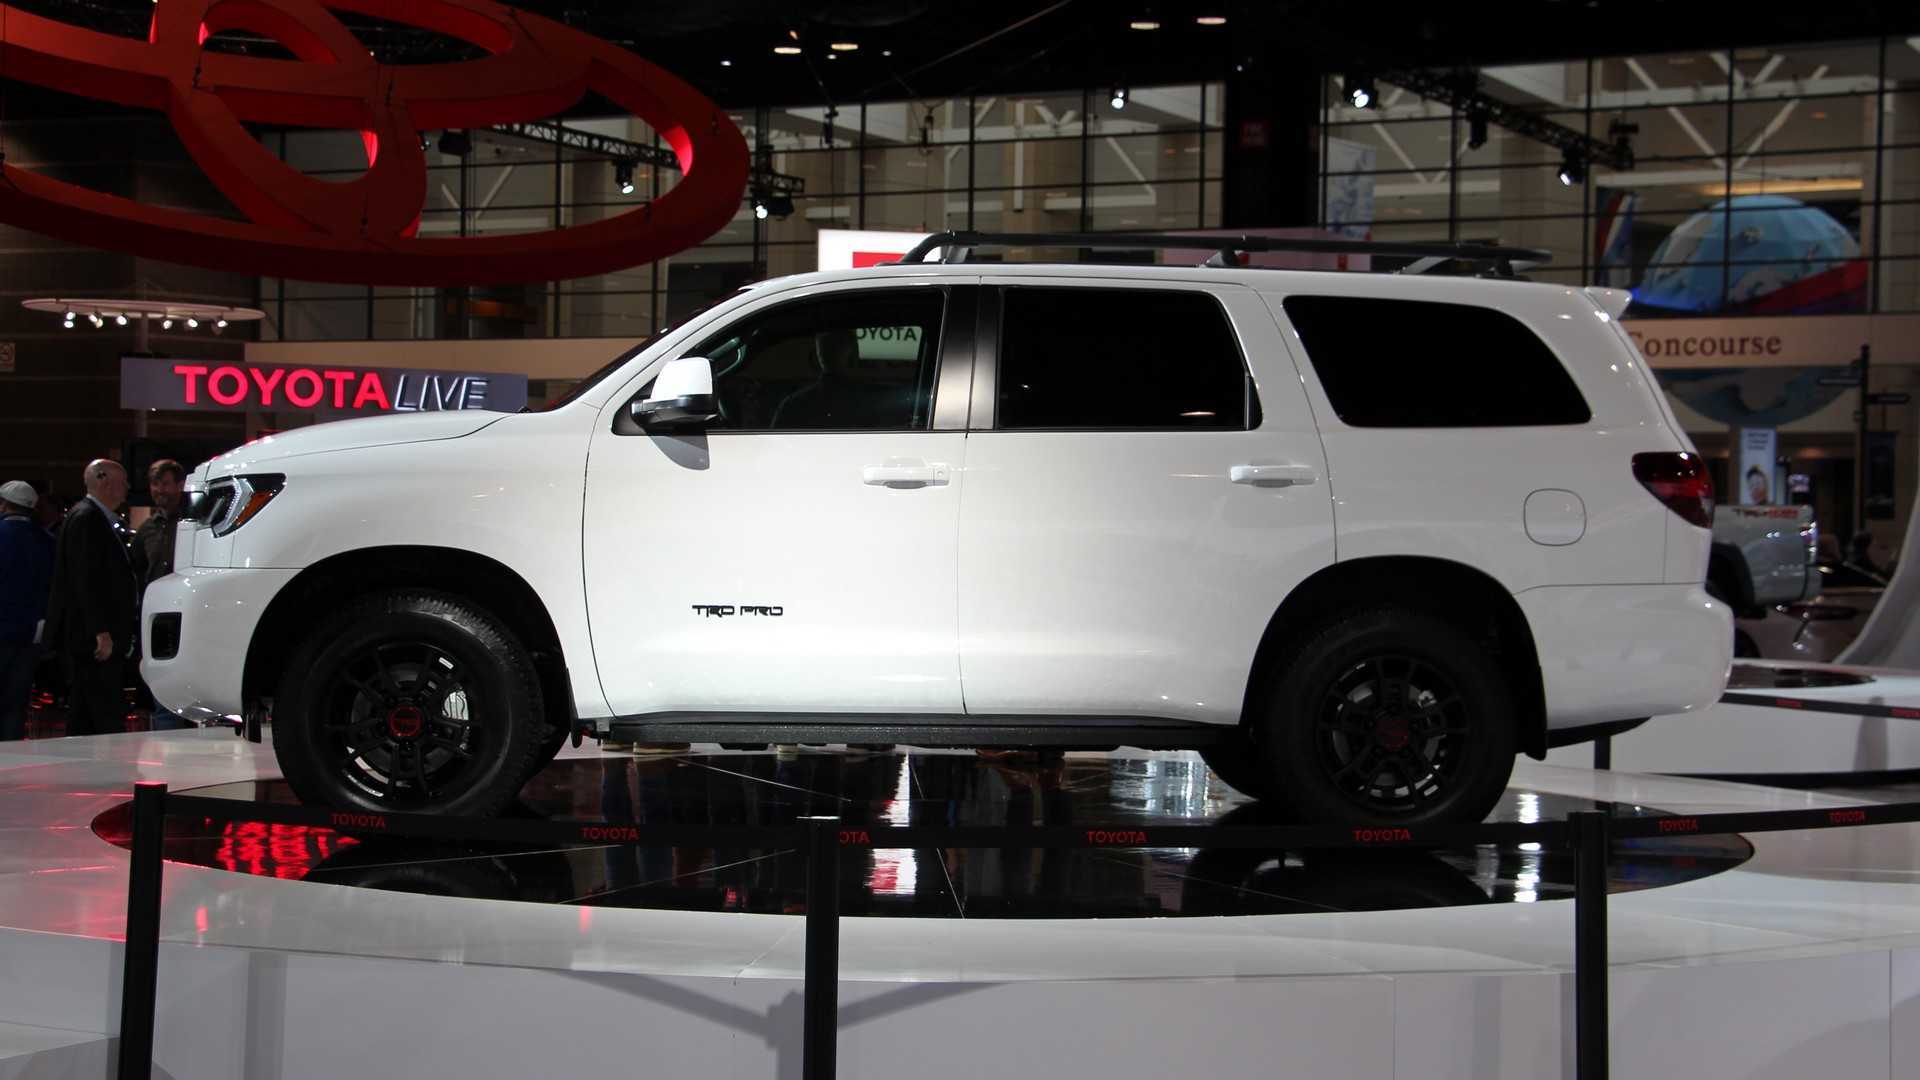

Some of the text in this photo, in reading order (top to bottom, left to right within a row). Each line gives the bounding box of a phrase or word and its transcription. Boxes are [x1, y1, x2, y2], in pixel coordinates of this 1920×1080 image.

[174, 365, 490, 411] TOYOTA LIVE
[692, 604, 783, 618] TRD PRO
[331, 813, 386, 829] TOYOTA
[1829, 810, 1866, 823] TOYOTA
[1658, 818, 1698, 832] TOYOTA
[582, 827, 638, 840] TOYOTA
[1087, 830, 1146, 844] TOYOTA
[1352, 829, 1411, 841] TOYOTA
